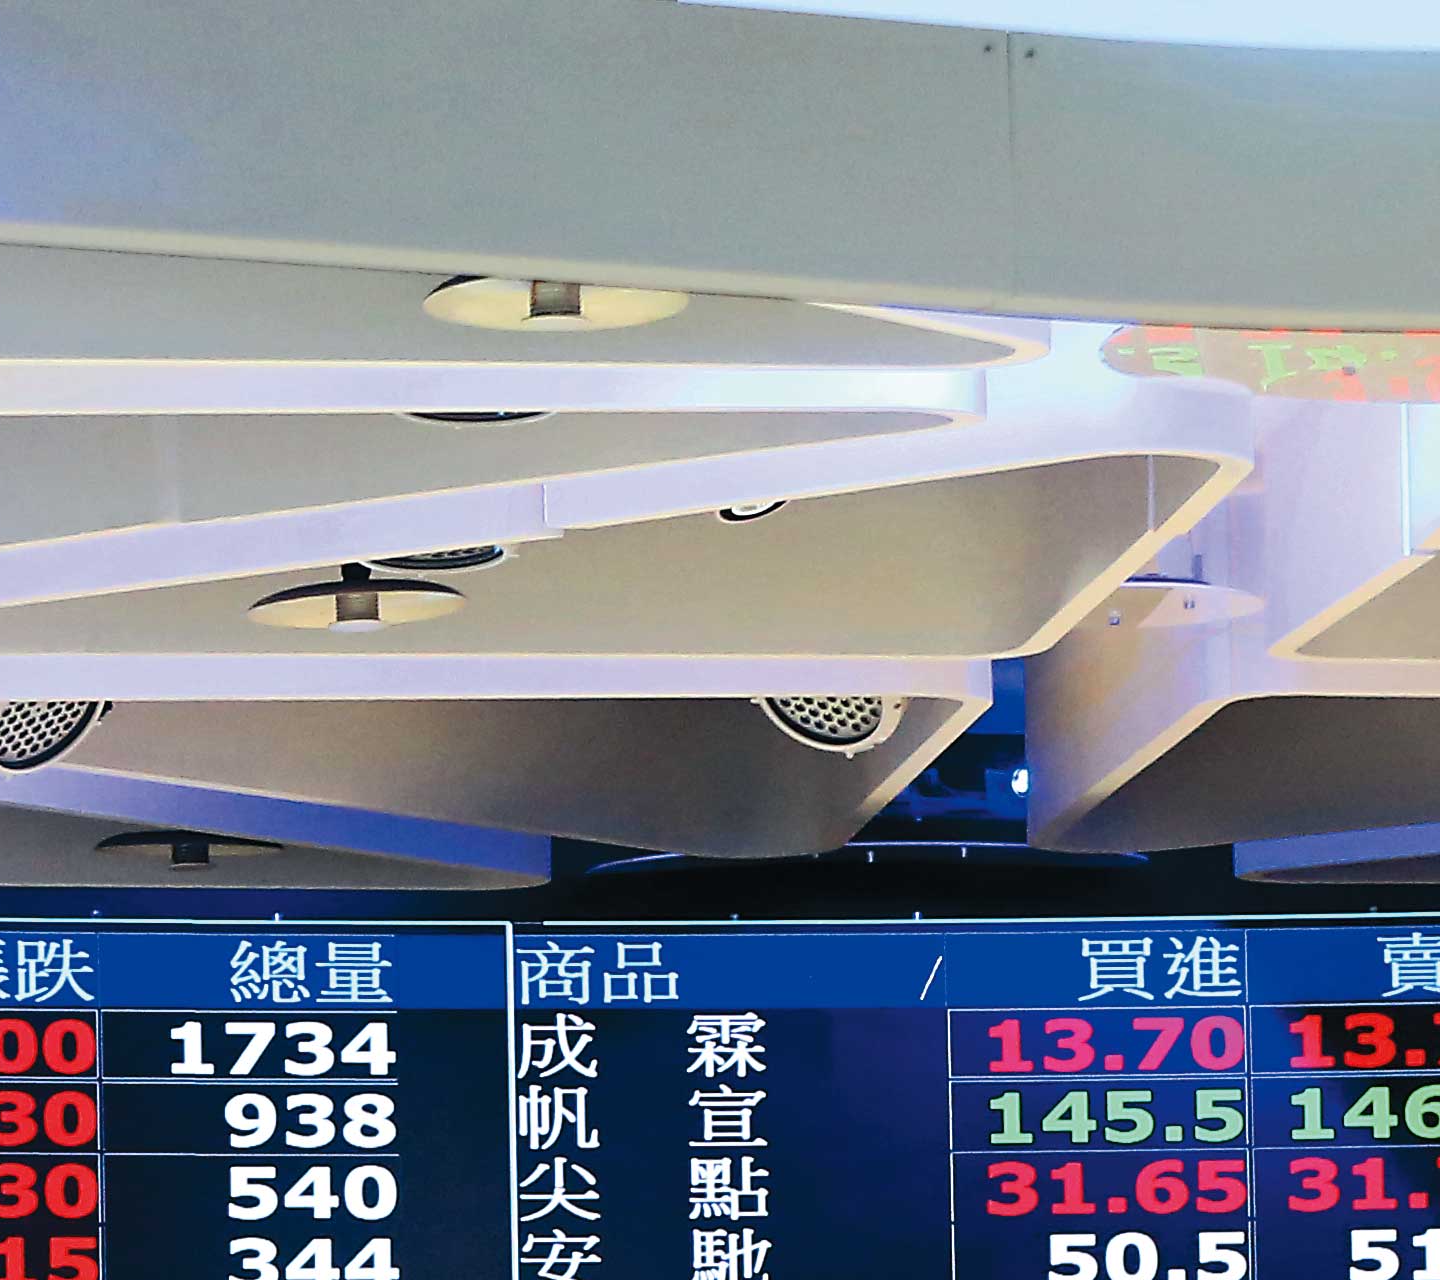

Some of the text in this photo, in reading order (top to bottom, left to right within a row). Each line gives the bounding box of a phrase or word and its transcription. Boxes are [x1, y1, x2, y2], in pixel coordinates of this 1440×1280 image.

[230, 941, 393, 1002] 總量
[520, 942, 677, 1004] 商品
[1080, 936, 1244, 1001] 買進
[172, 1022, 395, 1075] 1734
[989, 1016, 1244, 1072] 13.70
